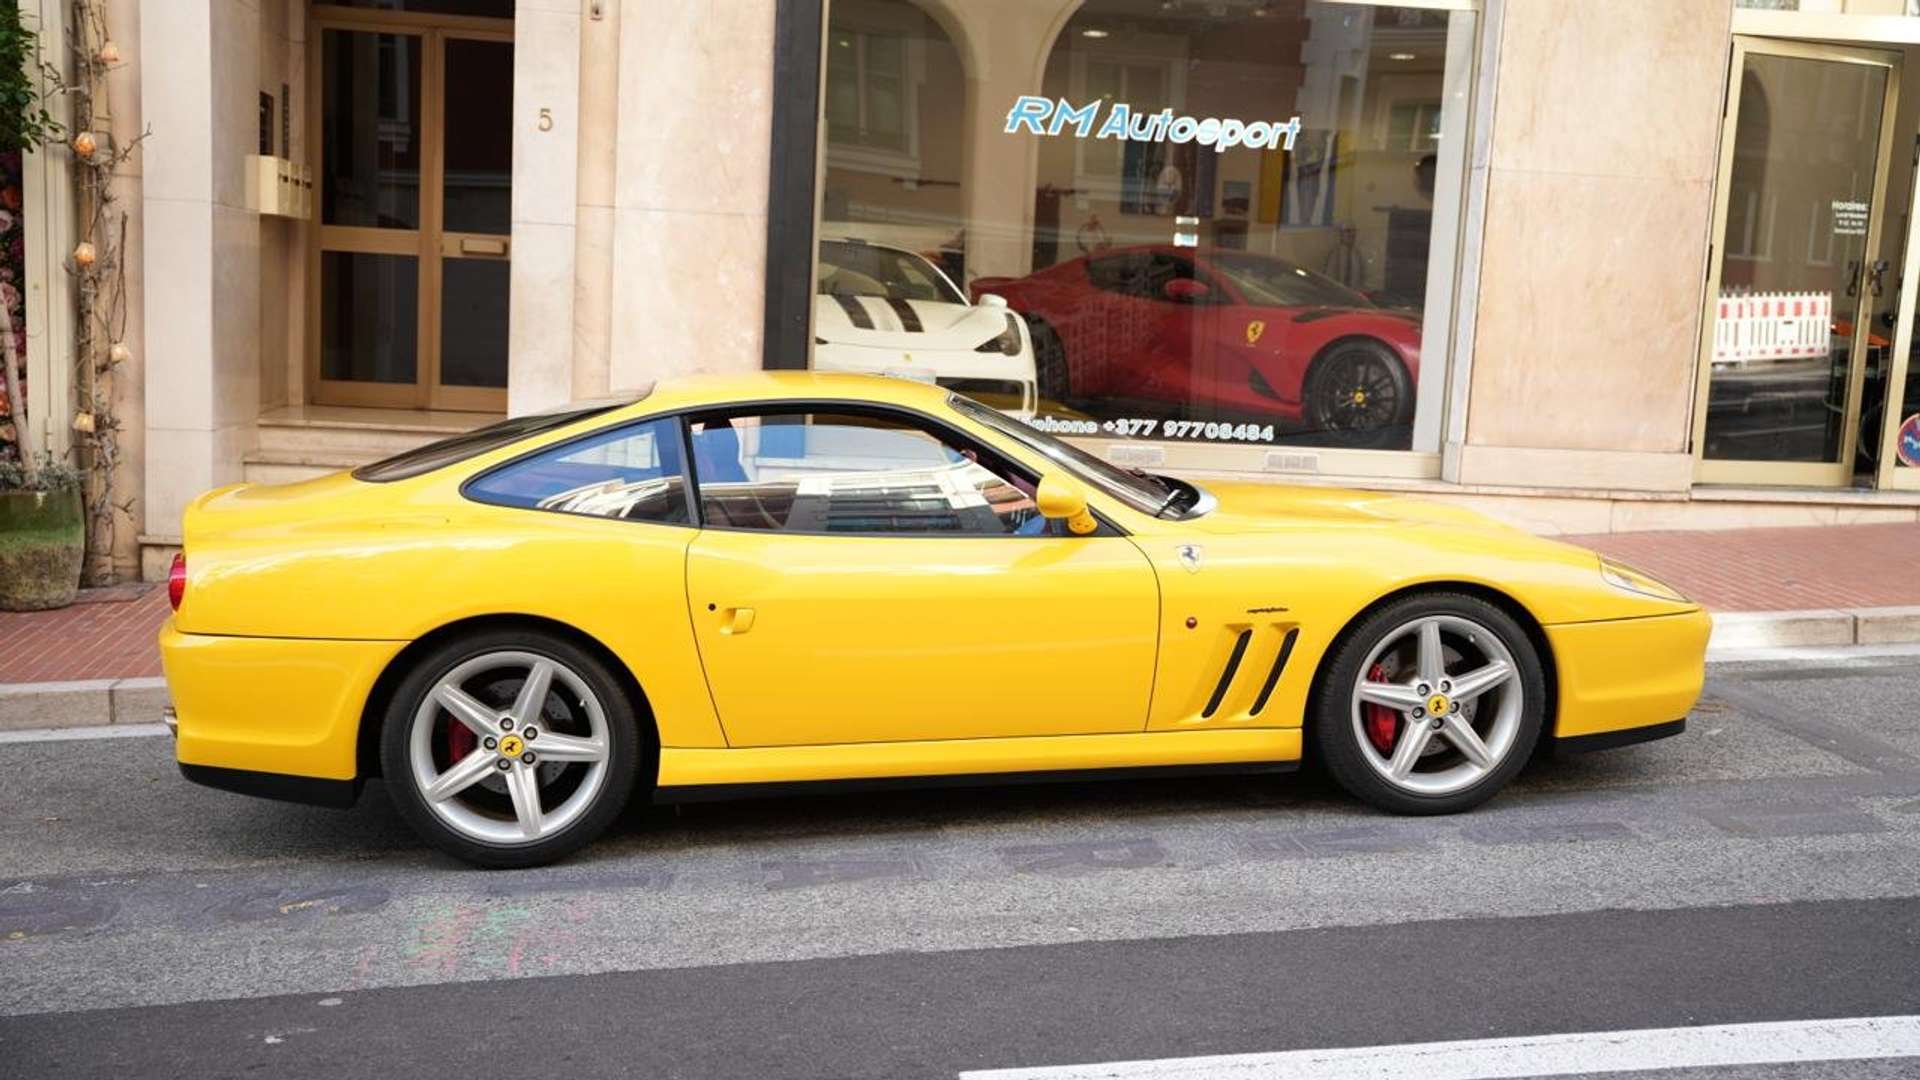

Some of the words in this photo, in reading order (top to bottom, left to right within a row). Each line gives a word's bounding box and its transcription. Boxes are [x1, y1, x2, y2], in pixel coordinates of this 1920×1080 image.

[538, 108, 553, 132] 5
[1004, 96, 1101, 137] RM
[1097, 103, 1300, 153] Autosport
[1103, 418, 1158, 437] +377
[1163, 420, 1275, 442] 97708484
